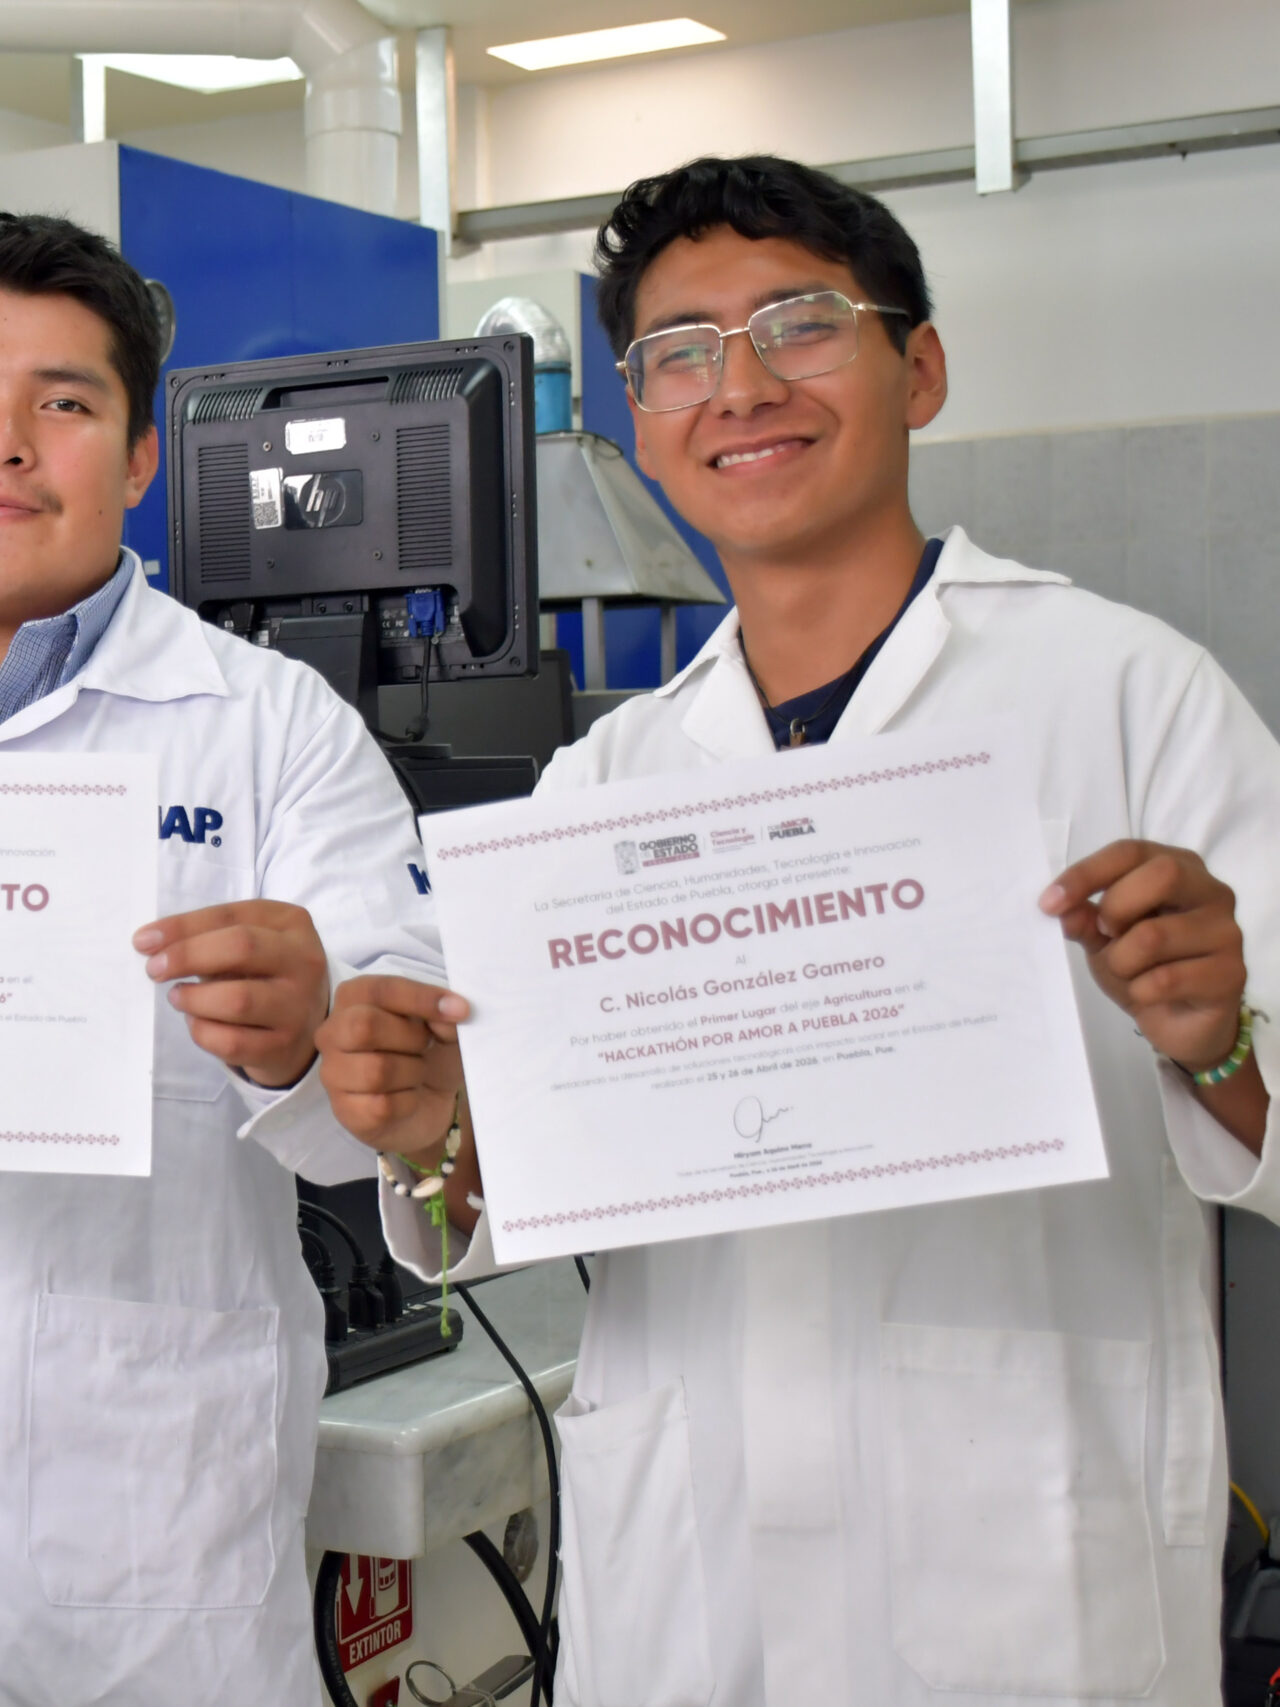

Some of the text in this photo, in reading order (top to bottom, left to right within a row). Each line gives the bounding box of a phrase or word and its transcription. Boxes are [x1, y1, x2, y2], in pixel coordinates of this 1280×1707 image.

[652, 842, 699, 859] ESTADO
[768, 824, 816, 840] PUEBLA
[547, 878, 925, 969] RECONOCIMIENTO
[599, 955, 885, 1013] C. Nicolás González Gamero
[570, 1036, 589, 1047] Por
[592, 1030, 626, 1043] haber
[630, 1020, 683, 1037] obtenido
[687, 1016, 698, 1028] el
[699, 1012, 739, 1025] Primer
[741, 1006, 776, 1019] Lugar
[779, 1000, 798, 1013] del
[801, 999, 820, 1011] eje
[823, 987, 892, 1007] Agricultura
[894, 984, 910, 994] en
[701, 1031, 734, 1047] POR
[738, 1023, 783, 1041] AMOR
[787, 1021, 798, 1033] A
[801, 1011, 859, 1031] PUEBLA
[349, 1620, 401, 1665] EXTINTOR
